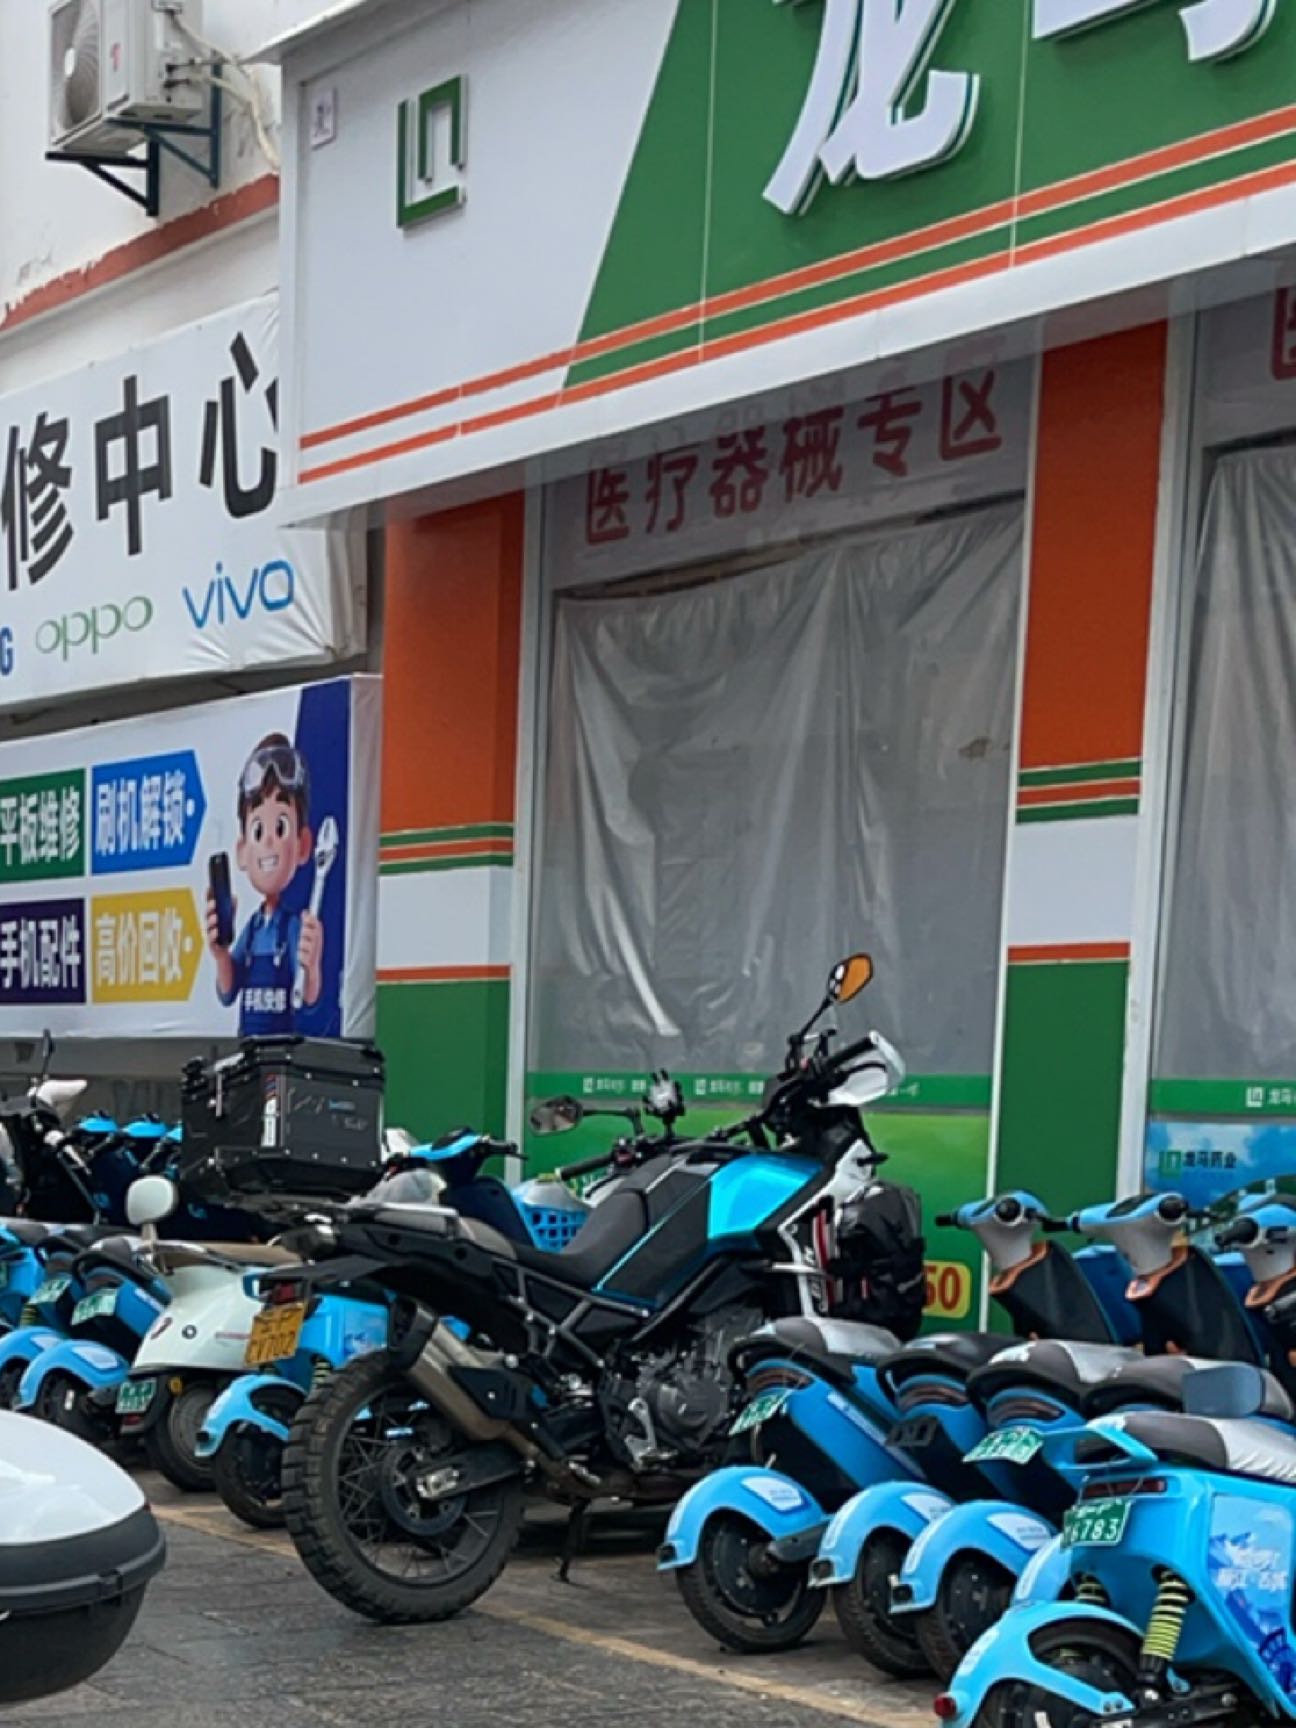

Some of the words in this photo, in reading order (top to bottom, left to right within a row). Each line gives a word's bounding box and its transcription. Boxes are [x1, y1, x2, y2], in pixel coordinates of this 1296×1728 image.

[586, 368, 1002, 546] 医疗器械专区
[35, 596, 153, 661] oppo
[182, 560, 295, 629] vivo
[0, 786, 80, 866] 平板维修
[95, 770, 186, 856] 刷机解锁
[0, 914, 81, 989] 手机配件
[96, 907, 184, 987] 高价回收
